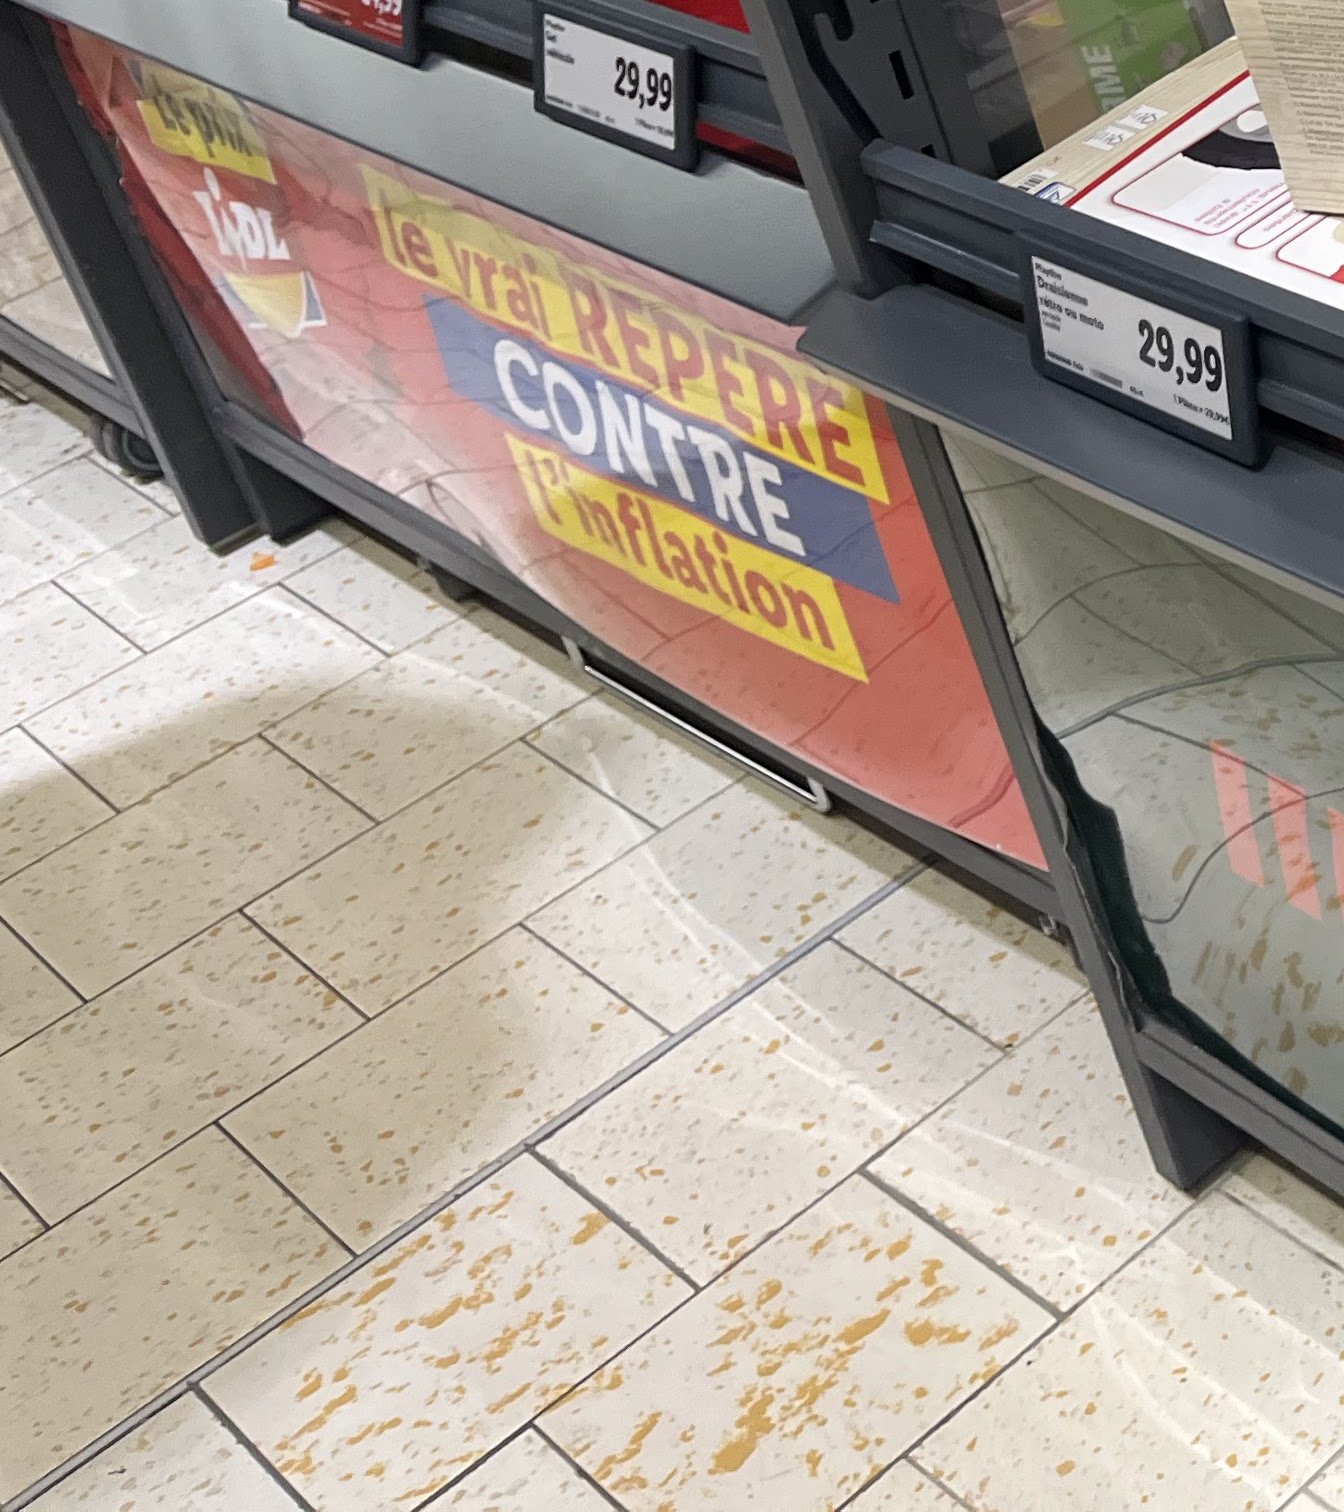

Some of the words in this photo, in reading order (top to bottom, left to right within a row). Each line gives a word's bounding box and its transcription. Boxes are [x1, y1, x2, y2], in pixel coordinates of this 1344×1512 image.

[615, 57, 672, 111] 29,99
[446, 240, 552, 337] vrai
[1138, 318, 1222, 392] 29,99
[493, 339, 806, 556] CONTRE
[522, 447, 836, 652] l'inflation
